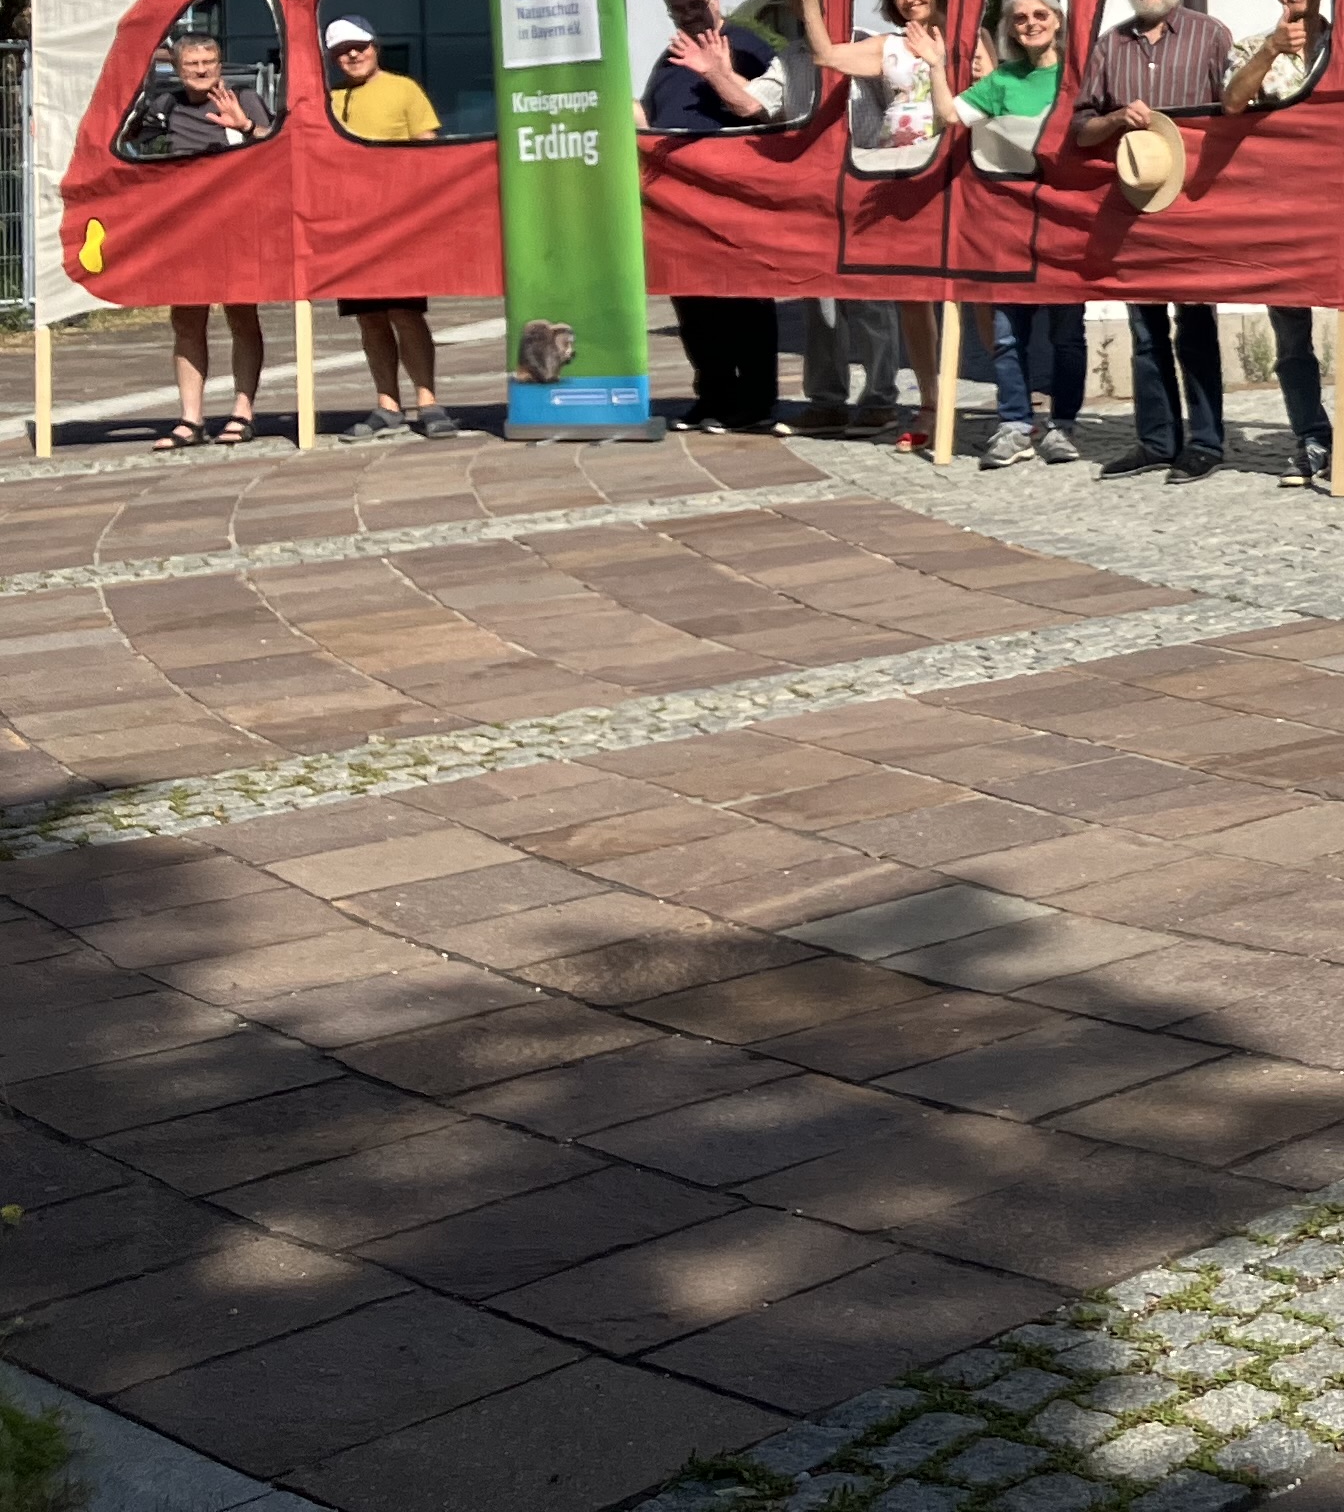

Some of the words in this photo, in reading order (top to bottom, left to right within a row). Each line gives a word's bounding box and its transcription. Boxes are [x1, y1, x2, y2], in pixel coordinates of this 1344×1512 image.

[516, 2, 579, 20] Naturschutz
[531, 23, 566, 40] Bayern
[512, 90, 599, 116] Kreisgruppe
[517, 122, 600, 167] Erding
